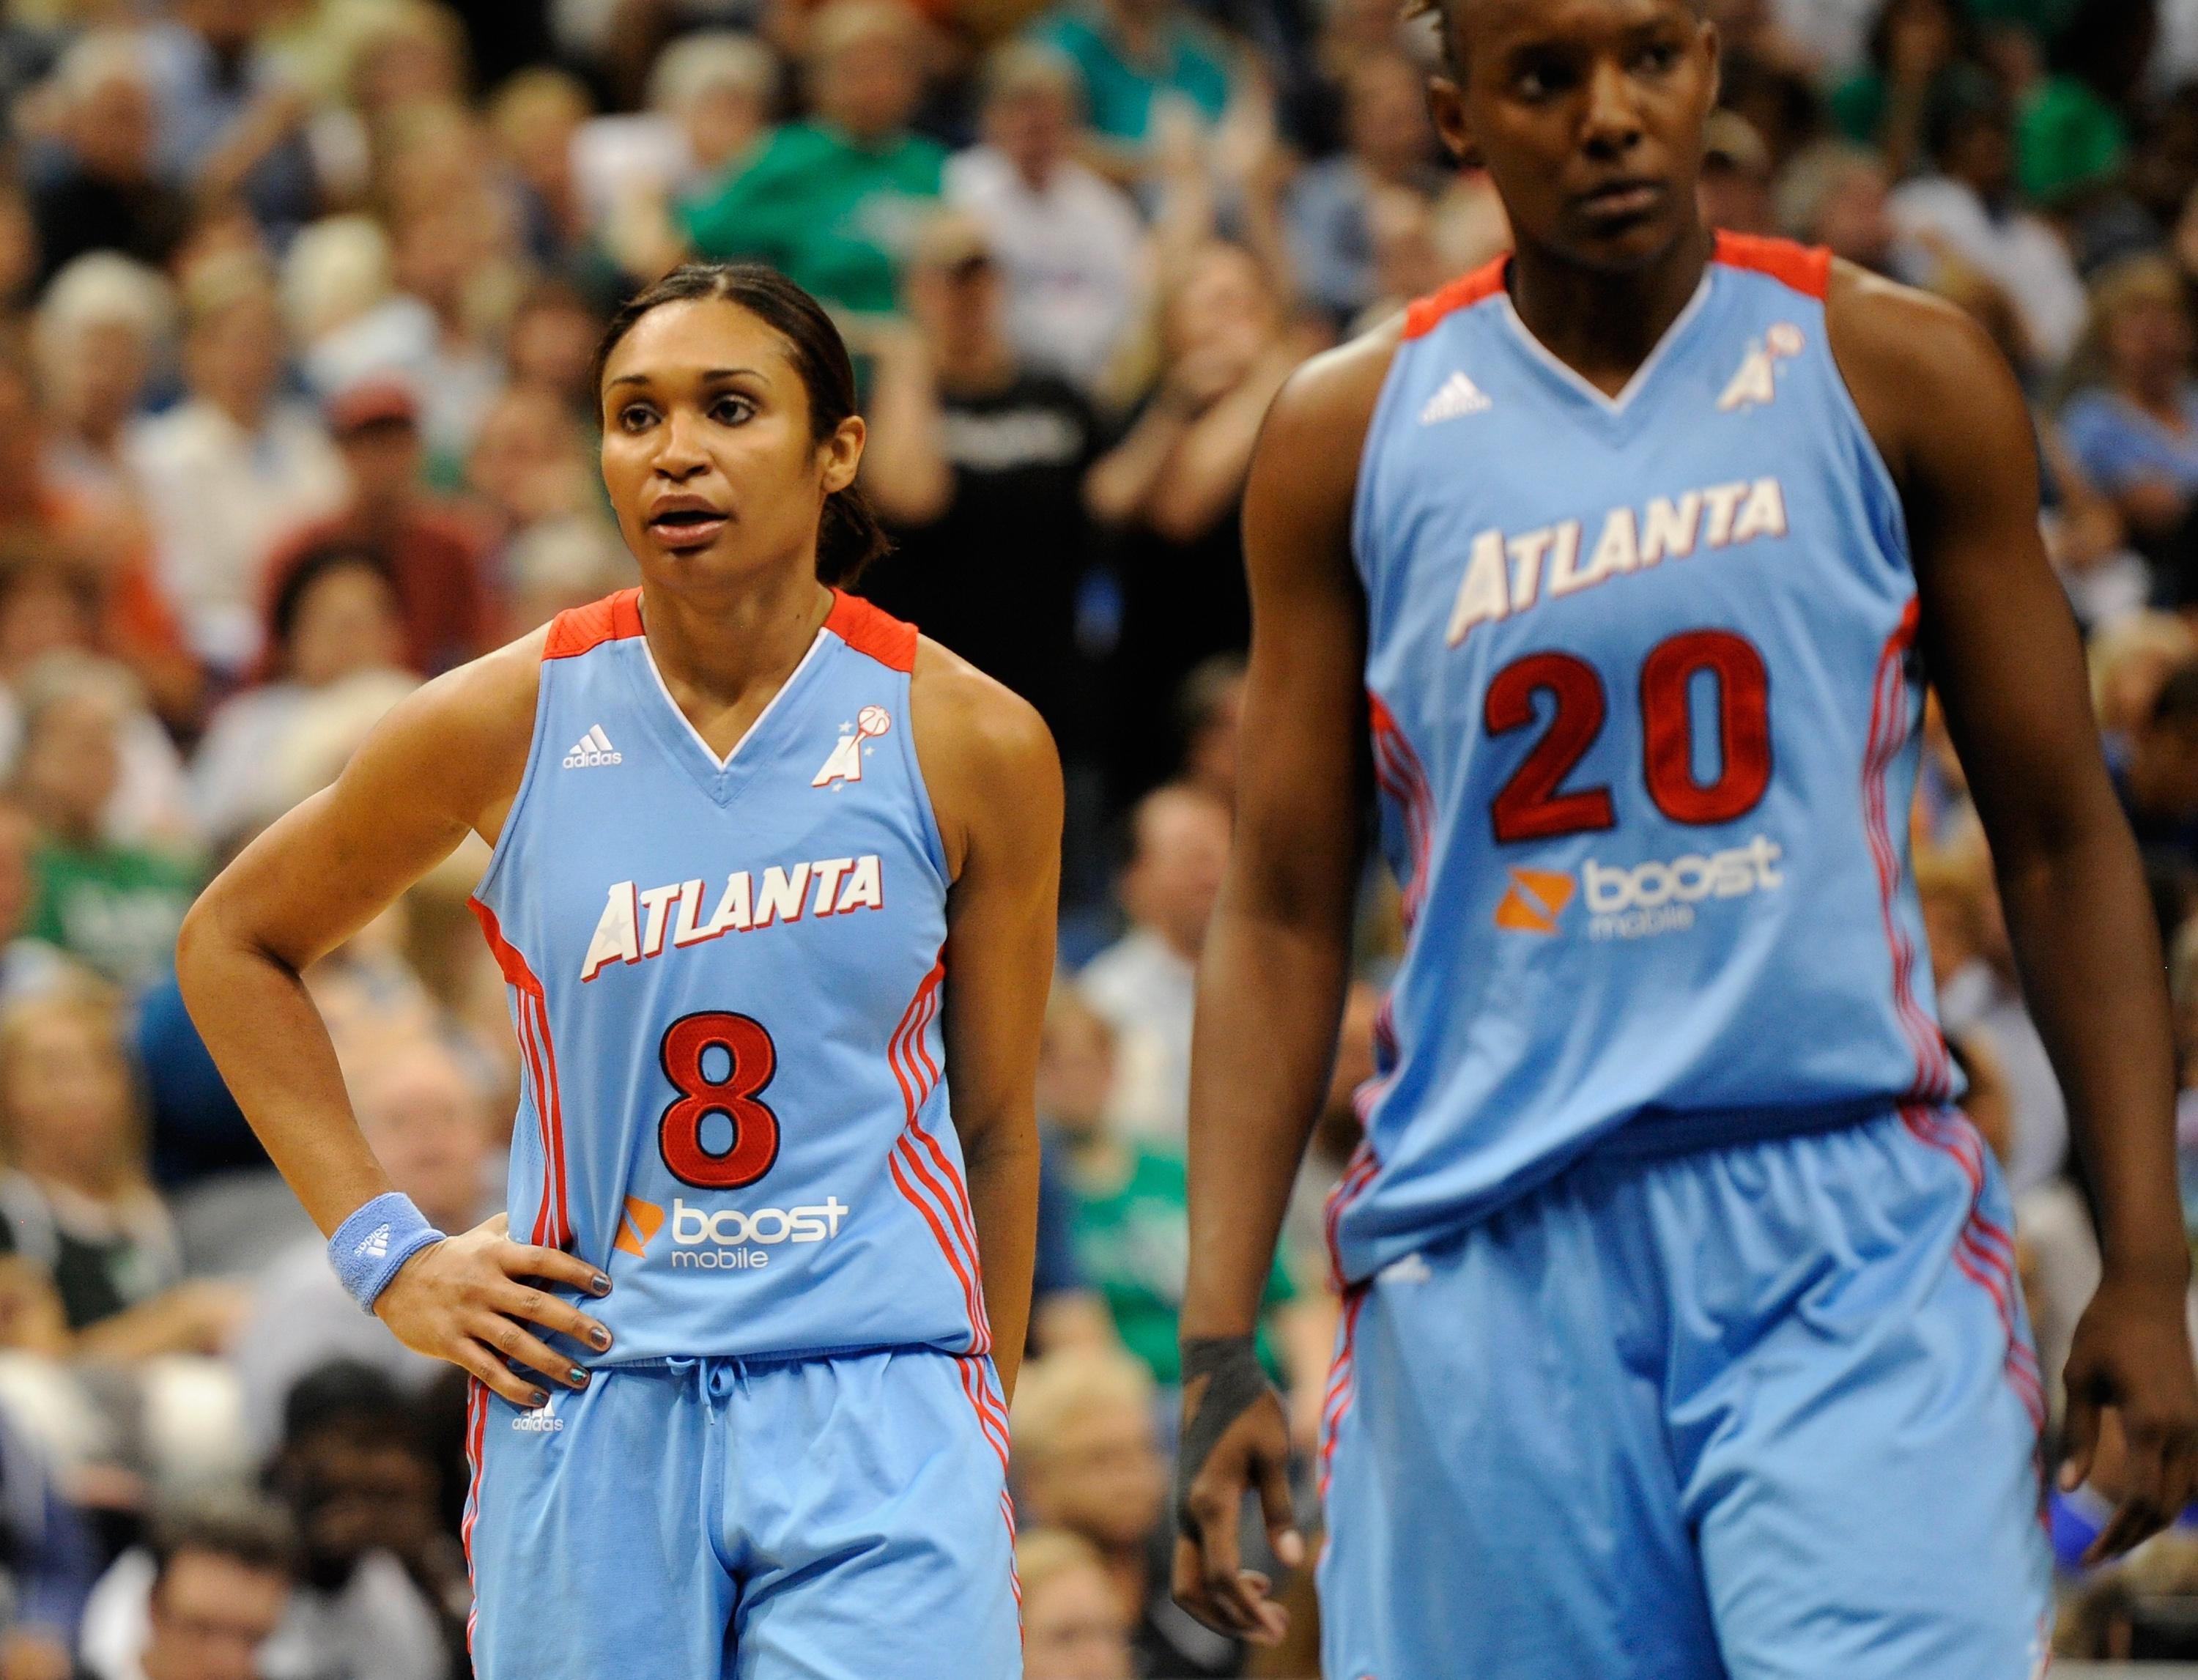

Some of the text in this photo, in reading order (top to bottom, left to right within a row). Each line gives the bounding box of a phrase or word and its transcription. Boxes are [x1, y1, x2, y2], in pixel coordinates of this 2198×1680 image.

[1446, 476, 1789, 649] ATLANTA
[563, 751, 622, 769] adidas
[1484, 629, 1774, 845] 20
[1583, 833, 1783, 914] boost
[580, 855, 884, 983] ATLANTA
[659, 1010, 780, 1189] 8
[353, 1223, 391, 1257] adidas
[672, 1196, 848, 1245] boost
[672, 1247, 769, 1269] mobile
[512, 1414, 564, 1432] adidas
